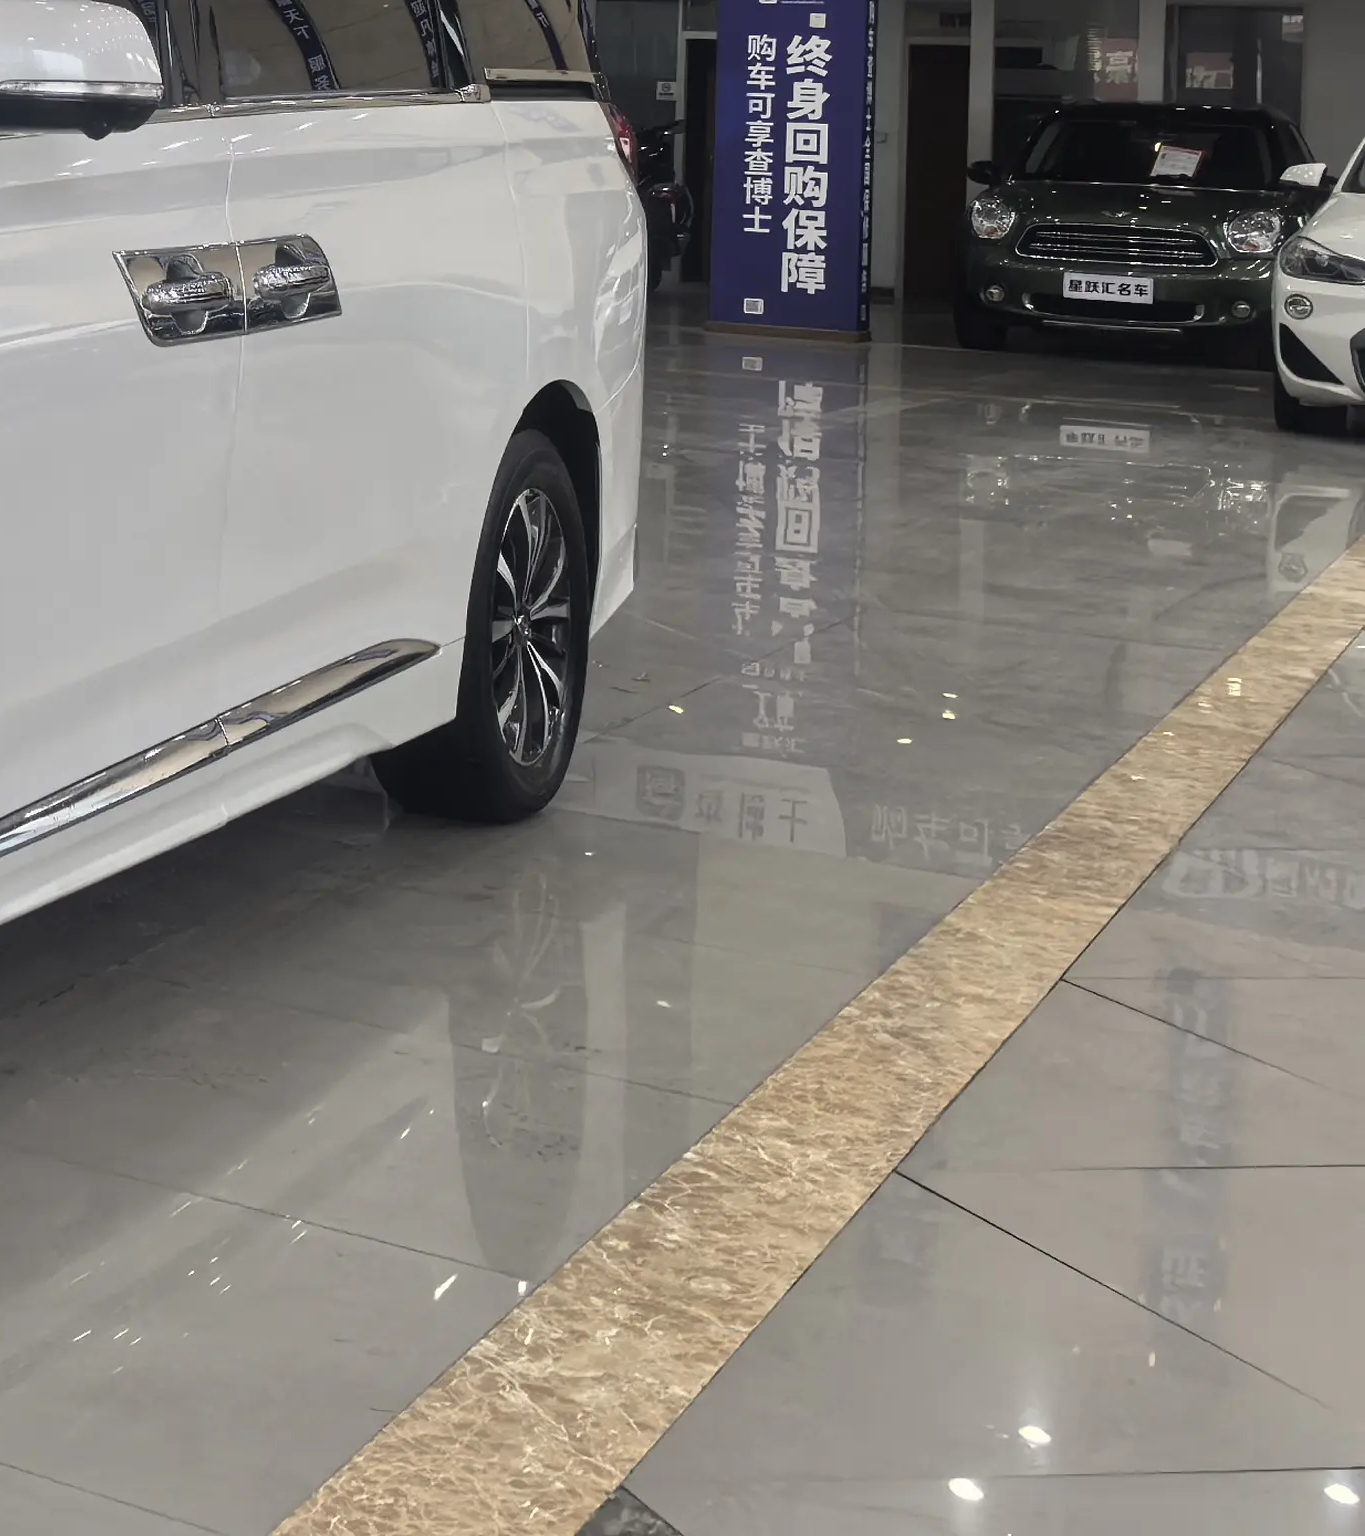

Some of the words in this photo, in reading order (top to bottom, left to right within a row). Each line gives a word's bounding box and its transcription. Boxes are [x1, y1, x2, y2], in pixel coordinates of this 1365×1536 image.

[743, 34, 777, 234] 购车可享查博士
[781, 35, 833, 295] 终身回购保障
[1068, 279, 1149, 297] 星跃汇名车
